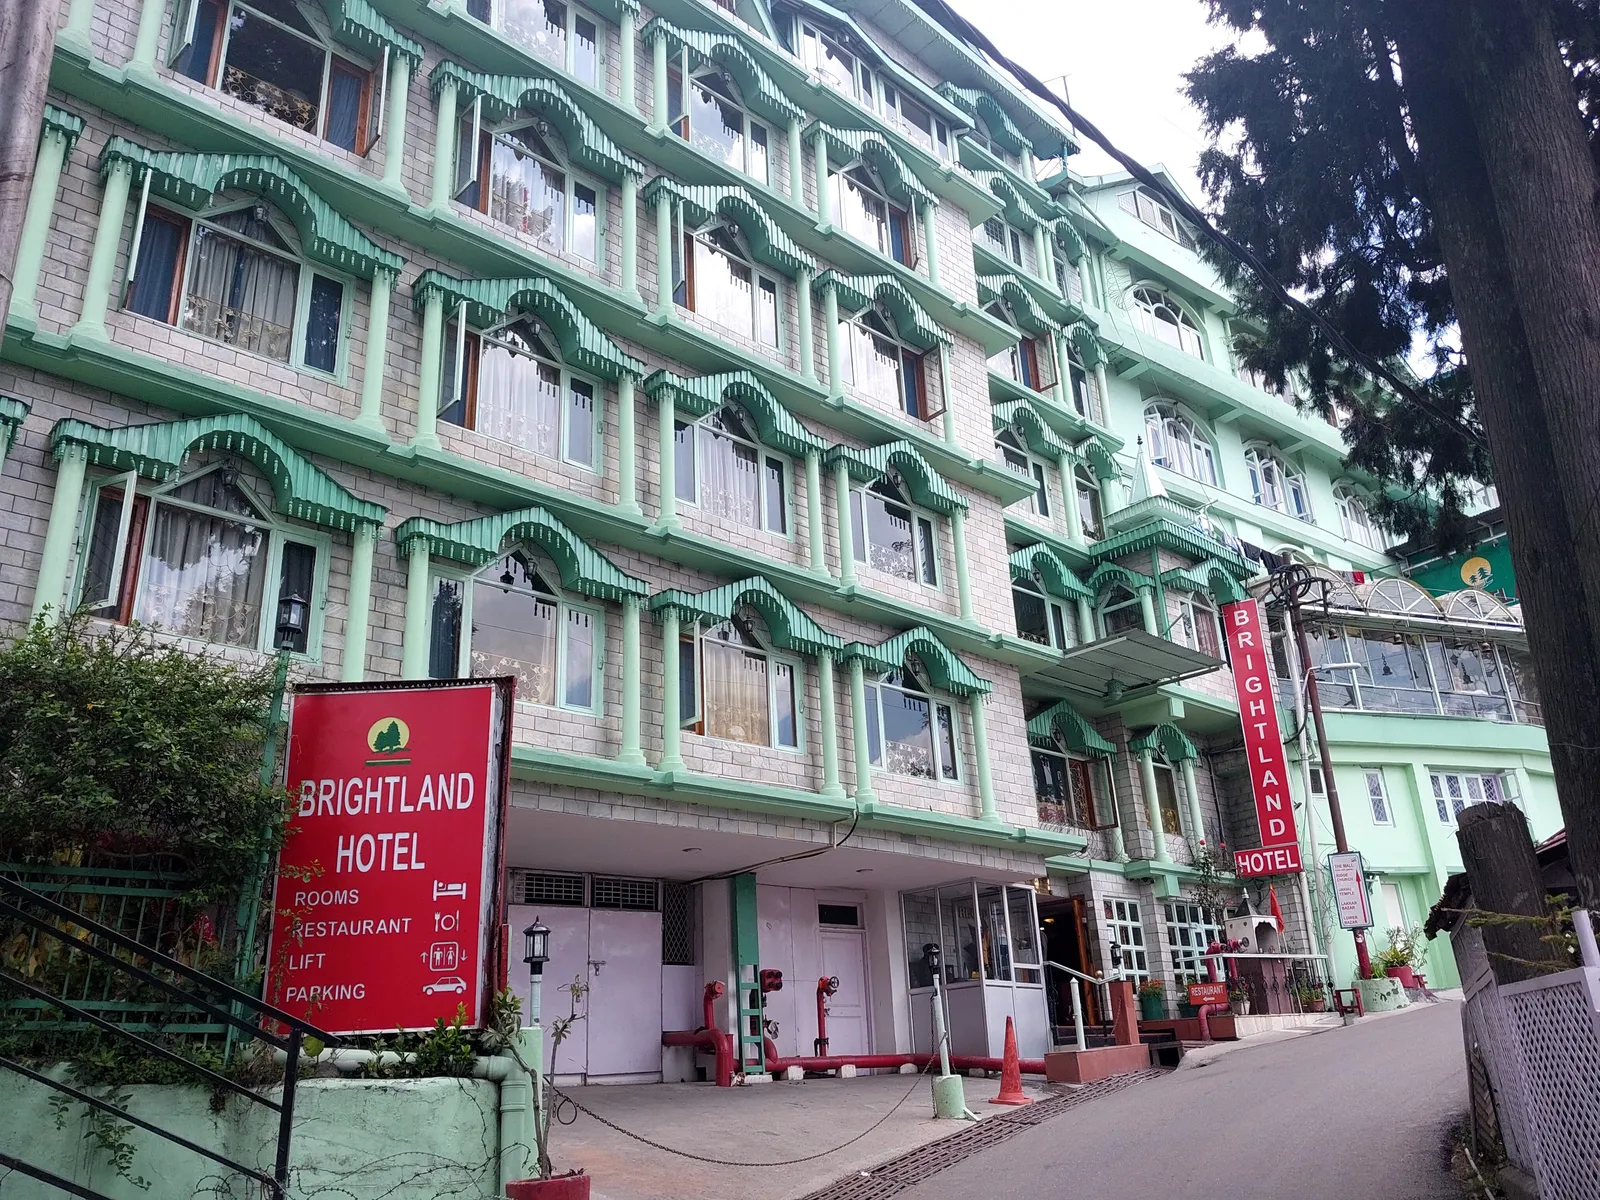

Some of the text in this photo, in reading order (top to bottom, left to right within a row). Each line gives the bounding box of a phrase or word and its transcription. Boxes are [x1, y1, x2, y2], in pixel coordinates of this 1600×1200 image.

[1234, 609, 1286, 838] BRIGHTLAND
[298, 772, 475, 817] BRIGHTLAND
[335, 832, 426, 873] HOTEL
[1238, 849, 1299, 873] HOTEL
[295, 889, 360, 906] ROOMS
[289, 953, 326, 970] LIFT
[286, 983, 366, 1003] PARKING
[1191, 985, 1224, 996] RESTAURANT
